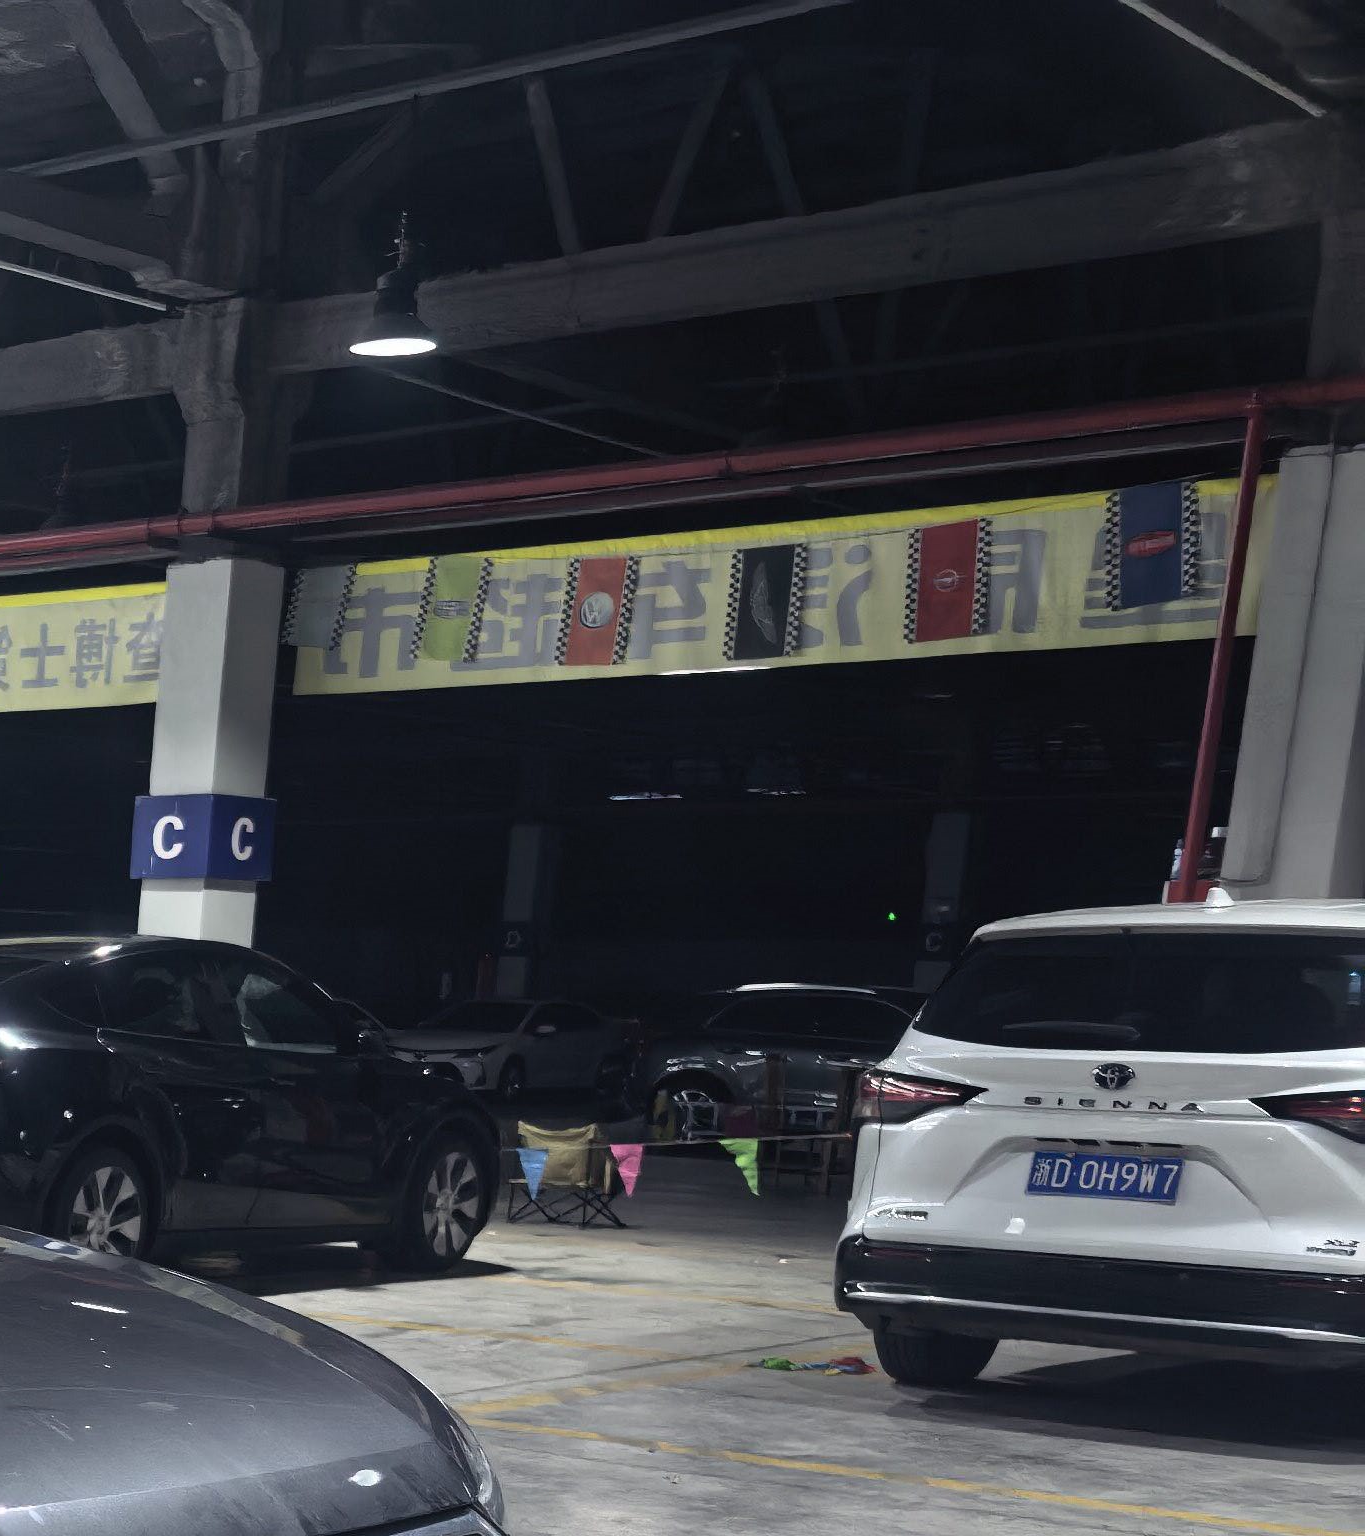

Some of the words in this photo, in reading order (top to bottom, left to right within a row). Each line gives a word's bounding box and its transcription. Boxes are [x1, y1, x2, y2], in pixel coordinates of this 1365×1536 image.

[153, 815, 185, 860] C
[231, 817, 255, 861] C
[1023, 1096, 1205, 1114] SIENNA
